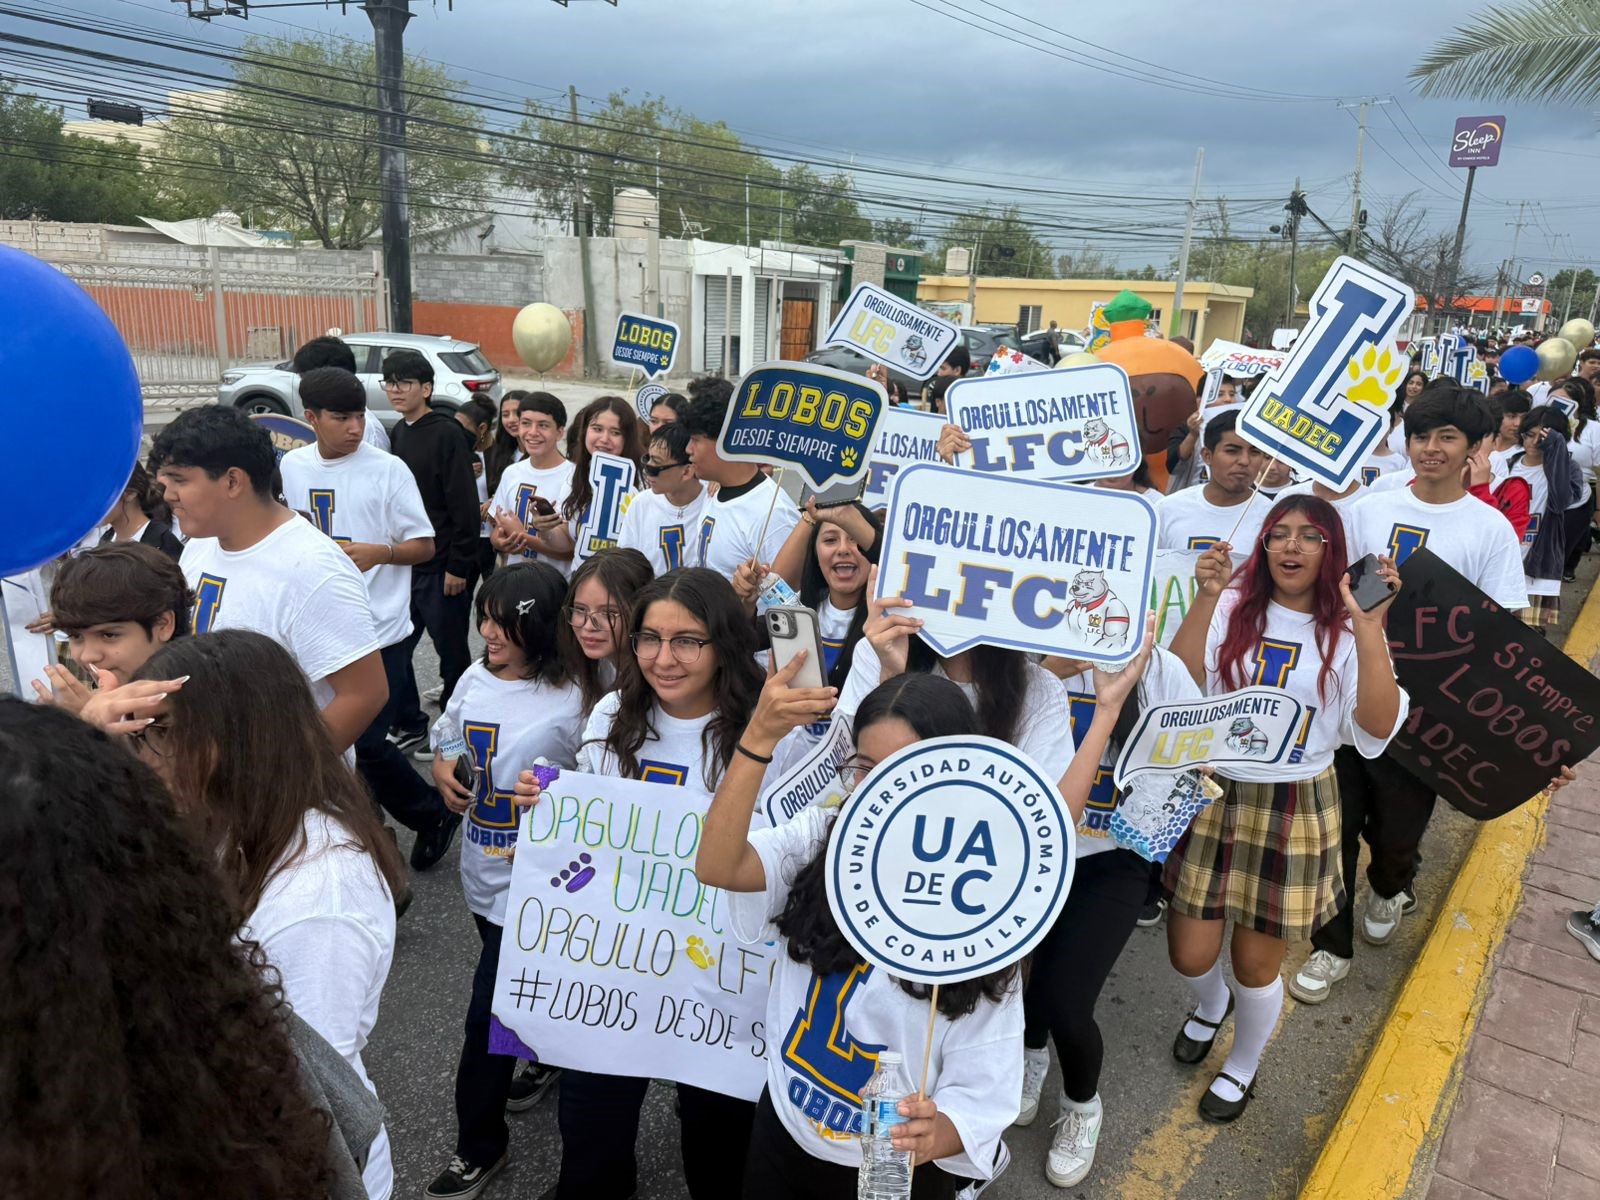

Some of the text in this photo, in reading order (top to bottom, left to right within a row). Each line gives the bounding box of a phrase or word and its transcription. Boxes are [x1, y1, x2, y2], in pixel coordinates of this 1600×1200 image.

[1453, 129, 1495, 151] Sleep
[619, 321, 674, 352] LOBOS
[848, 310, 897, 354] LFC
[863, 294, 945, 342] ORGULLOSAMENTE
[614, 346, 660, 365] DESDE SIEMPRE
[739, 381, 874, 440] LOBOS
[959, 390, 1120, 433] ORGULLOSAMENTE
[1260, 397, 1343, 456] UADEC
[731, 428, 838, 463] DESDE SIEMPRE
[969, 430, 1086, 472] LFC
[902, 501, 1136, 573] ORGULLOSAMENTE
[897, 551, 1070, 631] LFC
[1160, 697, 1281, 729] ORGULLOSAMENTE
[1438, 663, 1572, 768] LOBOS
[1493, 642, 1595, 733] Siempre
[1150, 727, 1215, 765] LFC
[1406, 705, 1501, 790] ADEC
[529, 791, 706, 860] ORGULLO
[849, 758, 971, 874] UNIVERSIDAD
[982, 764, 1053, 875] AUTÓNOMA
[912, 814, 998, 867] UA
[904, 869, 993, 916] DE C
[517, 896, 777, 995] ORGULLO LF
[855, 899, 1028, 963] DE COAHUILA
[509, 967, 769, 1061] #LOBOS DESDE S
